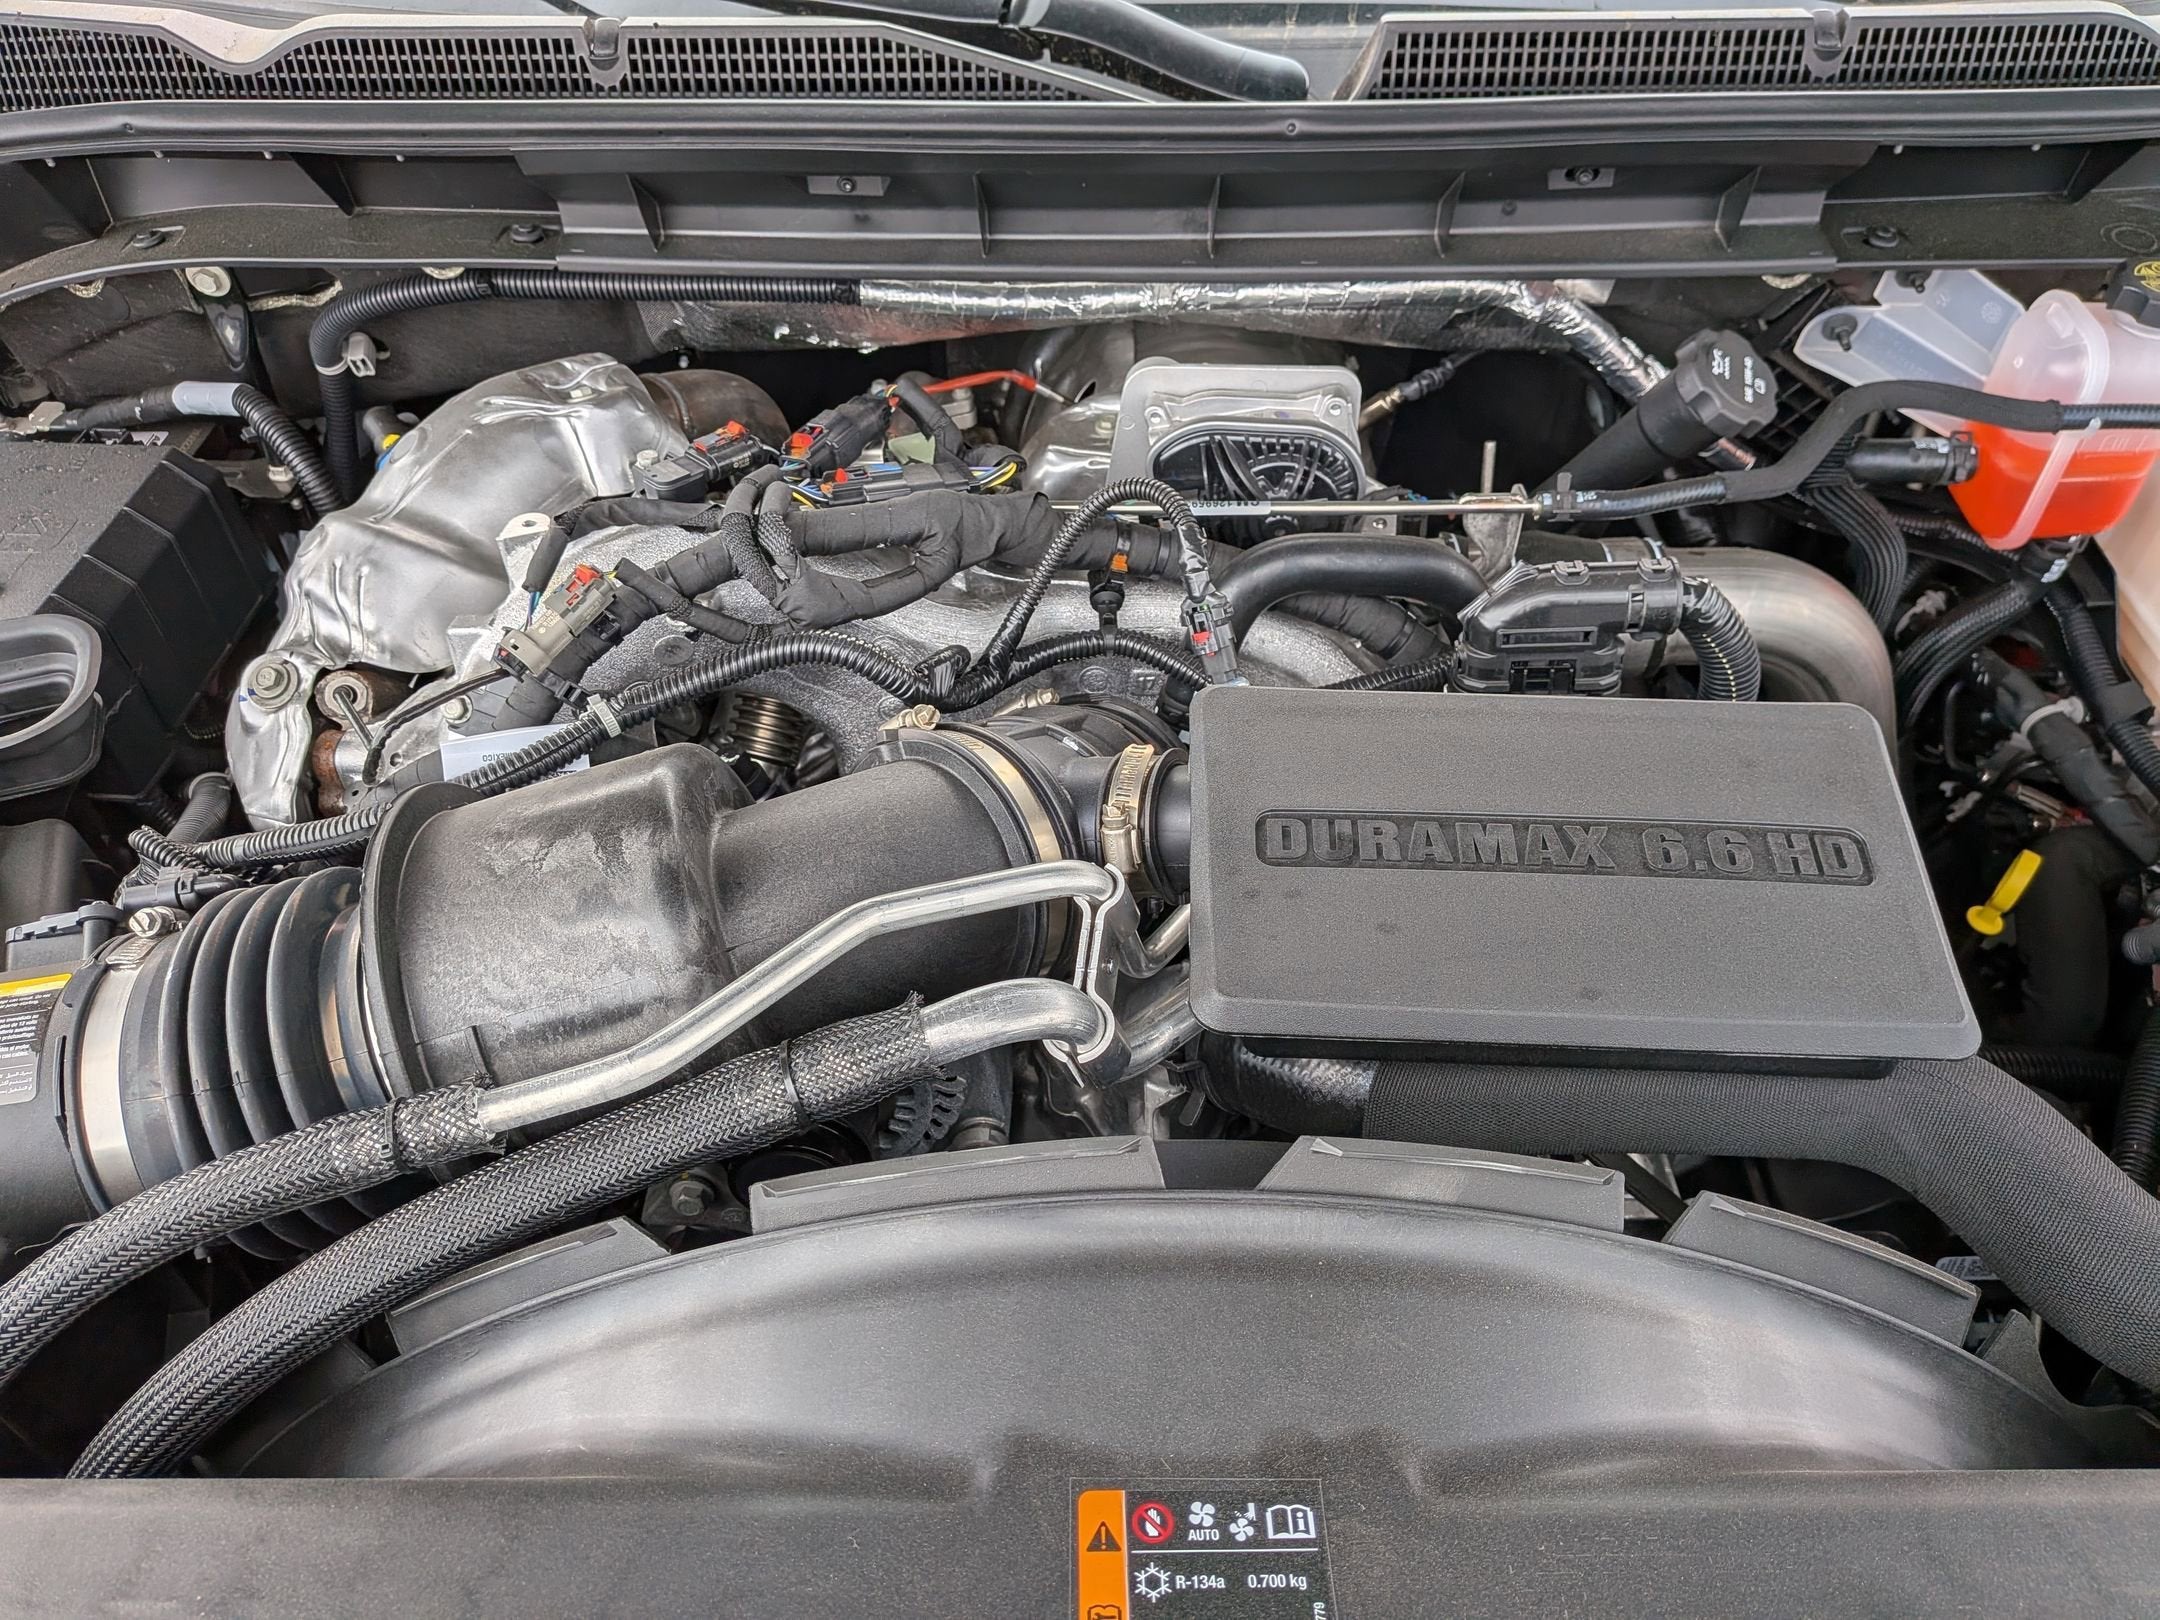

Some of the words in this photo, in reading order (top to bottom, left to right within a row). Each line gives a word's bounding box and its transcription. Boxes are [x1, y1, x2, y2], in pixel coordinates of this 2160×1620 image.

[1265, 817, 1615, 869] DURAMAX
[1641, 826, 1754, 874] 6.6
[1766, 829, 1866, 880] HD
[1188, 1529, 1220, 1541] AUTO
[1175, 1574, 1226, 1589] R-134a
[1247, 1574, 1287, 1589] 0.700
[1289, 1573, 1307, 1590] kg
